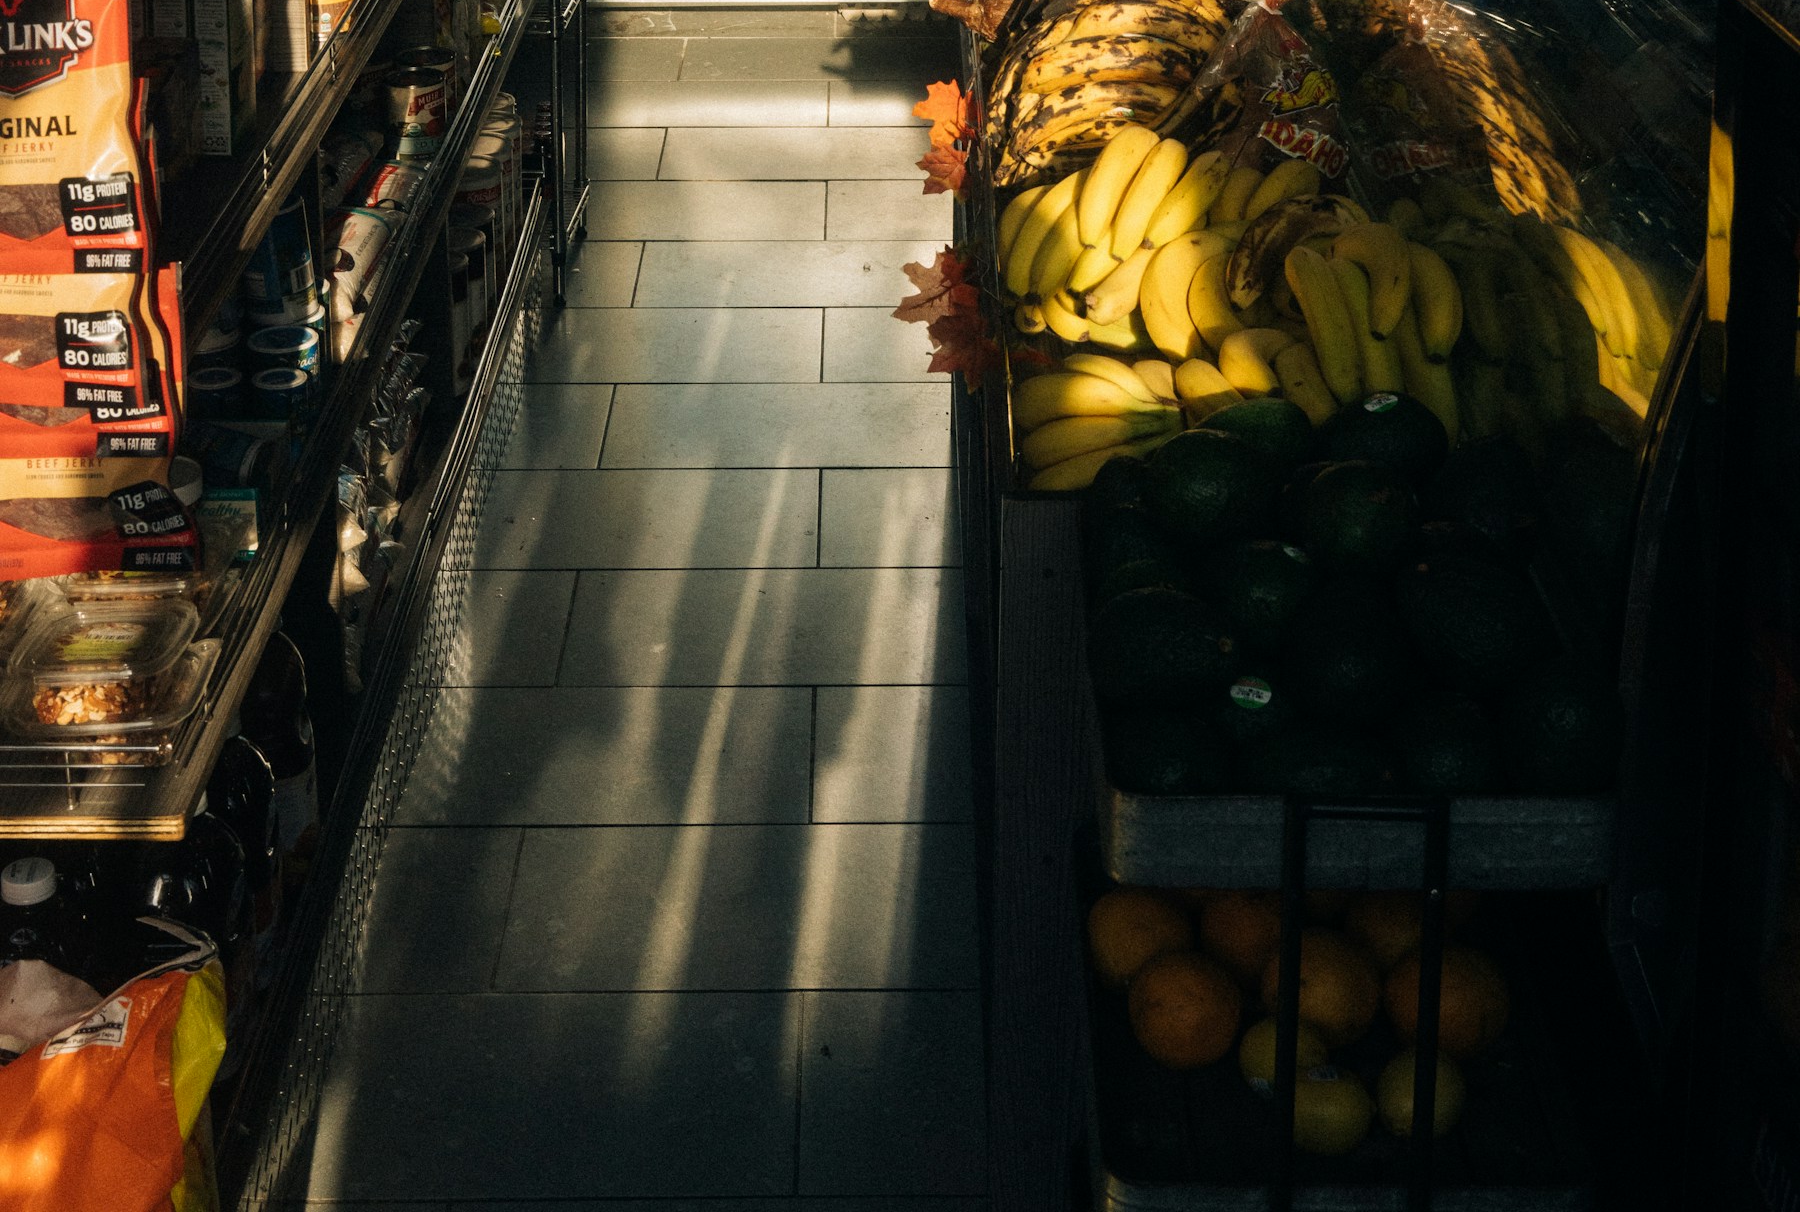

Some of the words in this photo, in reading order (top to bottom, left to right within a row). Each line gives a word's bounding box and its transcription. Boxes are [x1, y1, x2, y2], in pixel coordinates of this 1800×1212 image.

[418, 90, 439, 106] MUIR
[14, 141, 54, 154] JERKY
[1258, 121, 1349, 179] IDAHO
[68, 183, 95, 202] 11g
[96, 181, 127, 198] PROTEIN
[71, 214, 96, 232] 80
[99, 213, 134, 230] CALORIES
[86, 254, 101, 267] 96%
[102, 254, 115, 267] FAT
[115, 254, 131, 267] FREE
[64, 319, 90, 338] 11g
[92, 319, 126, 334] PROTEIN
[64, 350, 90, 366] 80
[92, 352, 127, 366] CALORIES
[117, 373, 129, 382] BEEF
[76, 388, 93, 402] 96%
[93, 389, 106, 402] FAT
[107, 390, 123, 403] FREE
[110, 438, 126, 451] 96%
[127, 438, 139, 451] FAT
[140, 438, 157, 451] FREE
[27, 459, 59, 469] BEEF
[65, 458, 103, 468] JERKY
[117, 493, 145, 510] 11g
[123, 522, 149, 534] 80
[151, 514, 185, 533] CALORIES
[135, 553, 152, 565] 96%
[152, 553, 166, 565] FAT
[166, 553, 183, 565] FREE
